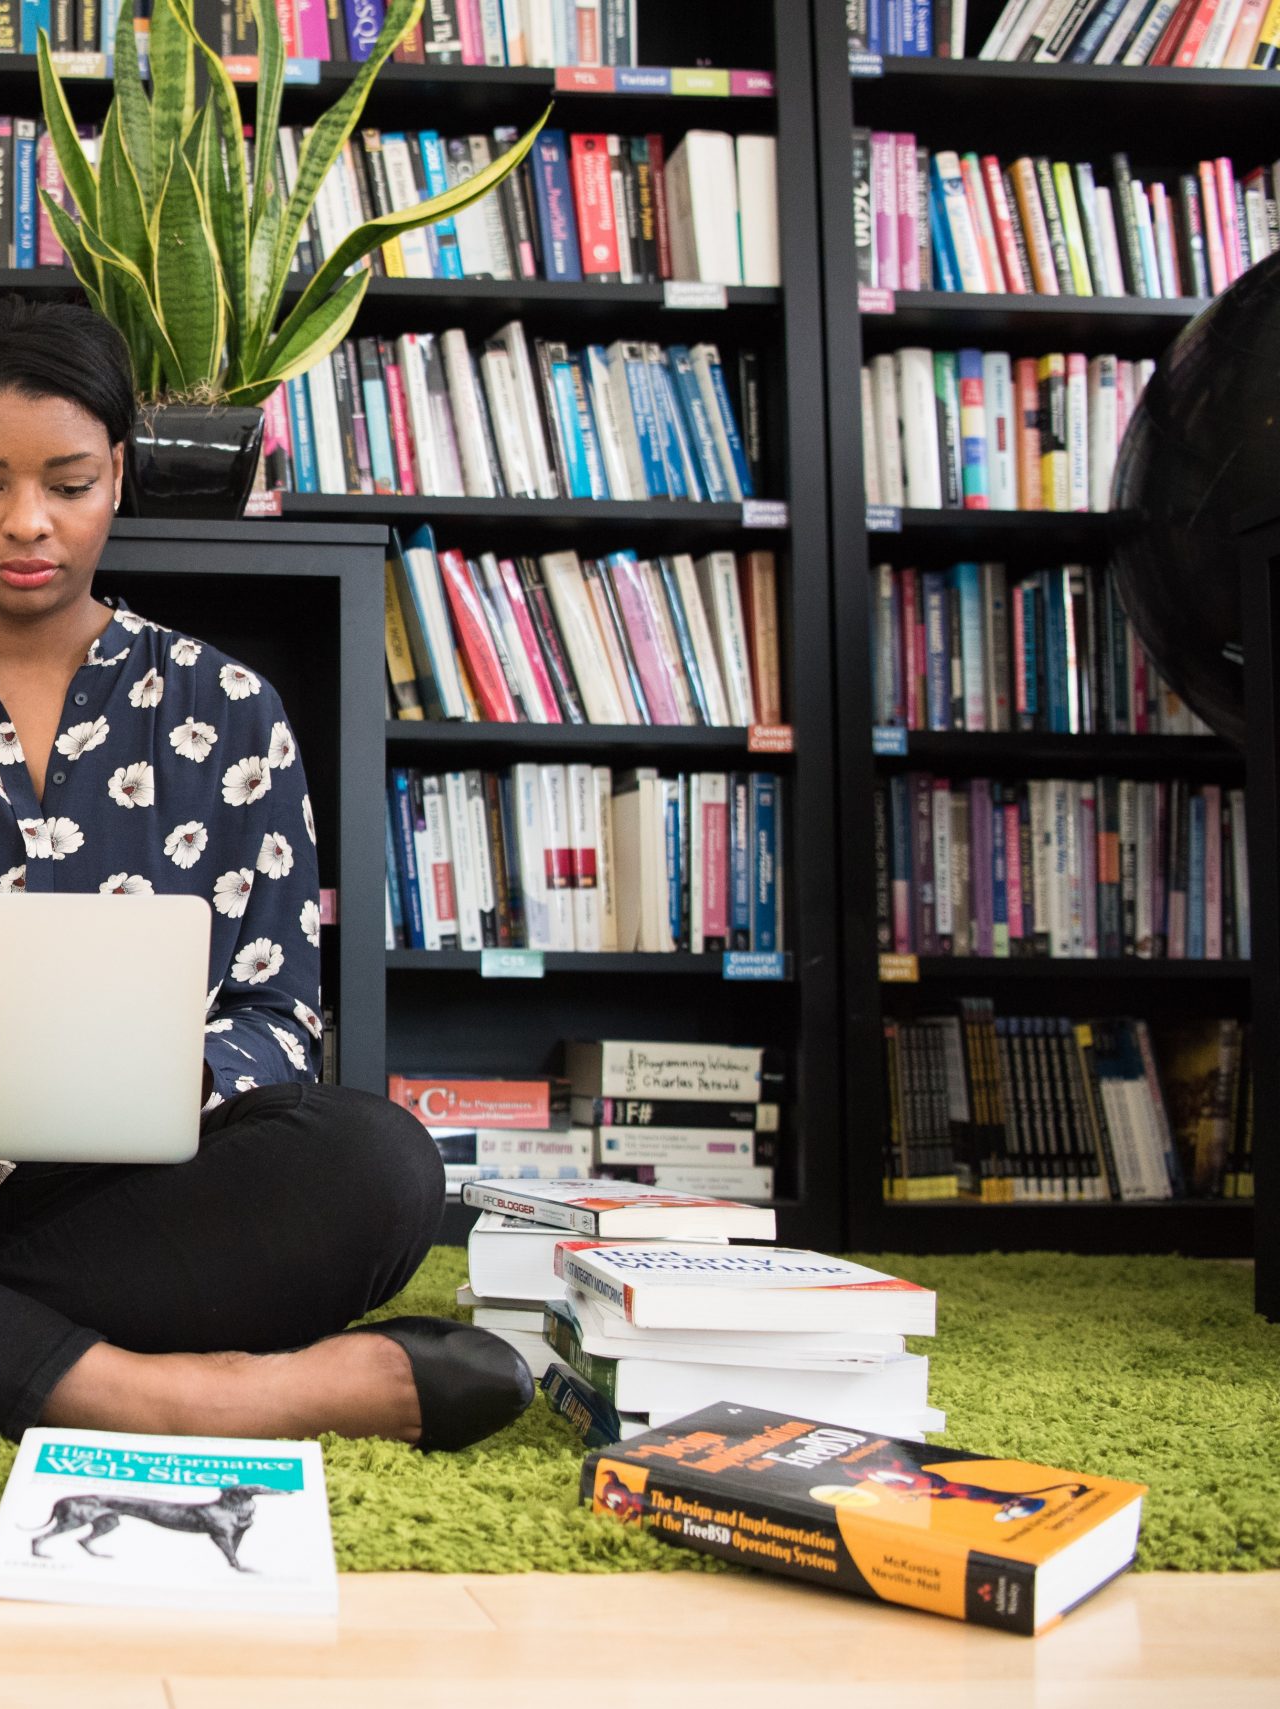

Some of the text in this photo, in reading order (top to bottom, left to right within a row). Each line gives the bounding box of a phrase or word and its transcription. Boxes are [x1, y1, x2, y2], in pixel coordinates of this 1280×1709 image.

[621, 75, 667, 87] Twisted
[20, 144, 32, 213] Programming
[46, 146, 58, 186] INSIDE
[583, 154, 596, 205] Windows
[596, 154, 612, 230] Programming
[546, 188, 566, 240] PowerShell
[638, 165, 652, 240] Dive Into Python
[736, 785, 746, 849] INTERNET
[502, 955, 525, 966] CSS
[727, 965, 780, 977] CompSci
[729, 953, 777, 964] General
[638, 1054, 705, 1073] Programming
[643, 1078, 693, 1088] Charles
[475, 1101, 532, 1110] Programmers
[626, 1101, 653, 1124] F#
[536, 1142, 573, 1154] Platform
[483, 1195, 535, 1215] PROBLOGGER
[604, 1255, 773, 1267] Integrity
[615, 1261, 853, 1275] Monitoring
[574, 1265, 623, 1307] INTEGRITY MONITORING
[49, 1446, 294, 1472] High Performance
[761, 1428, 866, 1469] FreeBSD
[46, 1457, 240, 1486] Web Sites
[651, 1490, 836, 1551] The Design and Implementation
[650, 1514, 837, 1572] of the FreeBSD Operating System
[883, 1555, 941, 1577] McKusick
[872, 1567, 941, 1592] Neville-Neil
